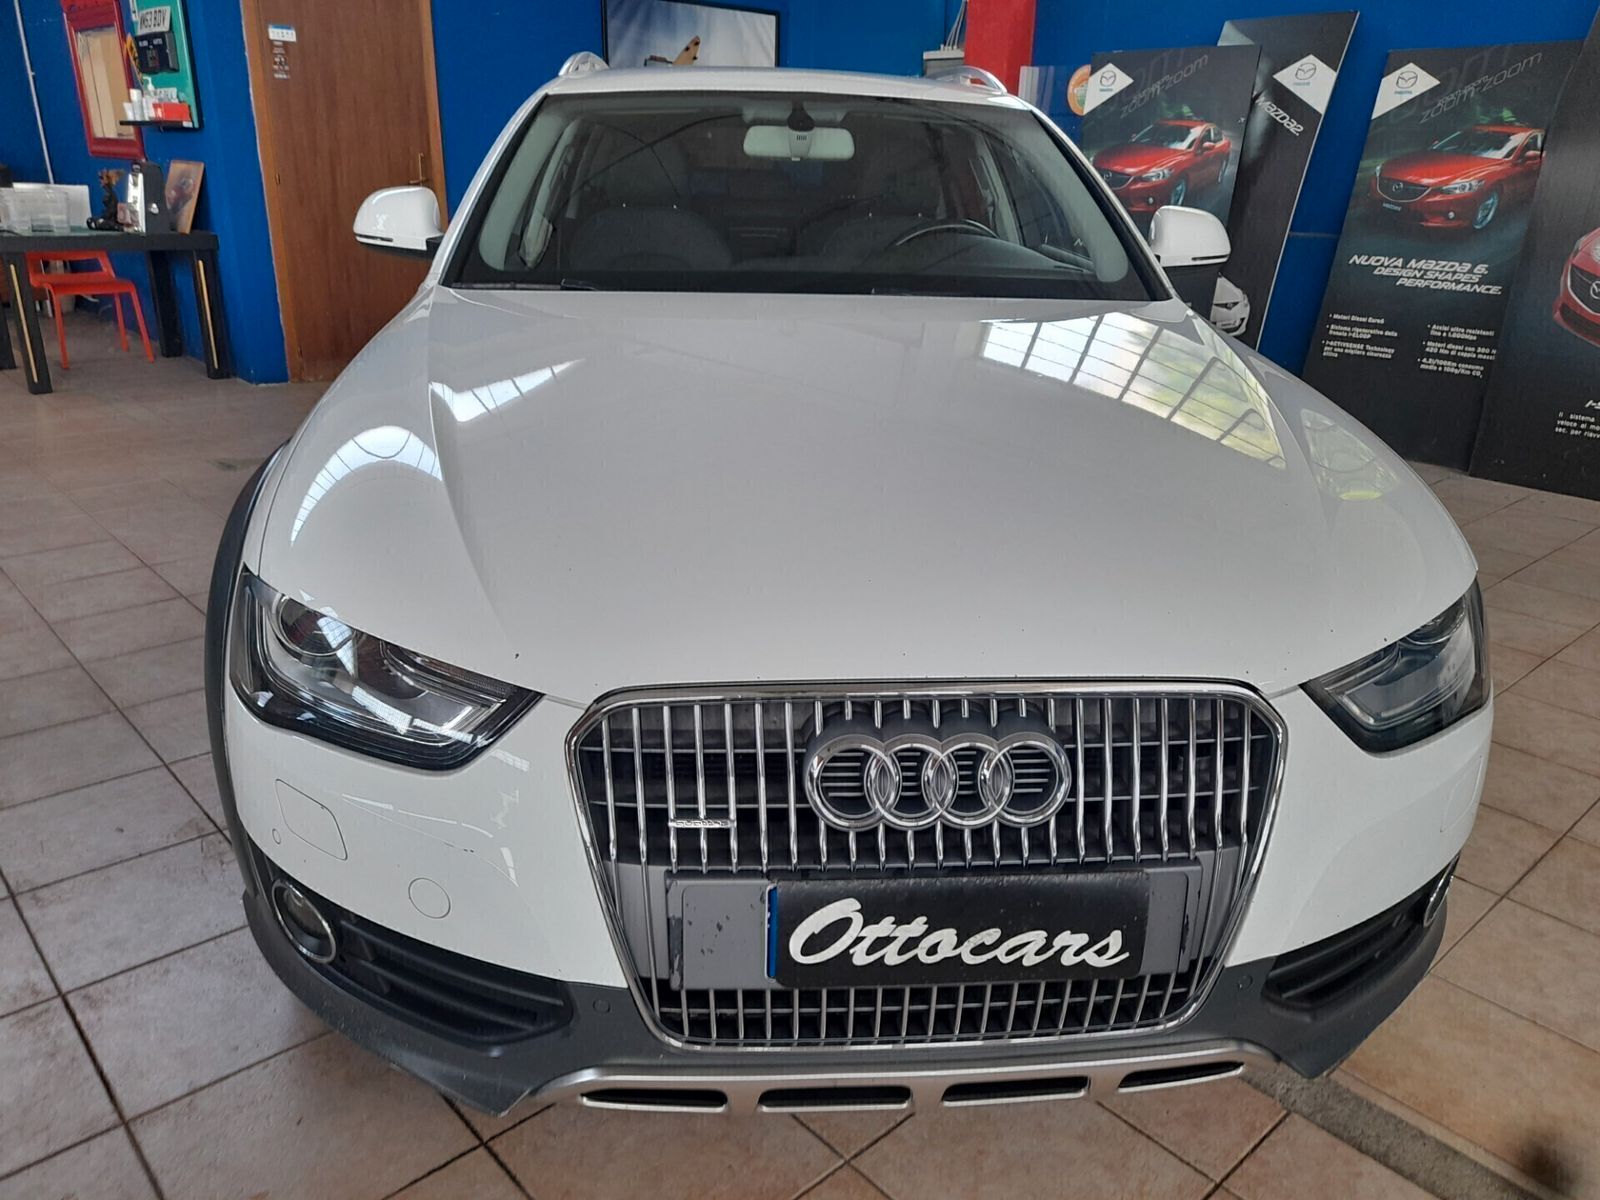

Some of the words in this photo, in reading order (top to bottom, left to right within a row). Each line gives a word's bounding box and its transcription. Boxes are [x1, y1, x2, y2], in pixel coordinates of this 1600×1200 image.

[1348, 254, 1403, 268] NUOVA
[1473, 264, 1489, 275] 6.
[1373, 266, 1424, 278] DESIGN
[1423, 270, 1482, 283] SHAPES
[1396, 277, 1503, 295] PERFORMANCE.
[1426, 340, 1447, 348] Motori
[1557, 419, 1578, 427] veloce
[1570, 413, 1595, 423] sistema
[788, 897, 1131, 968] Ottocars
